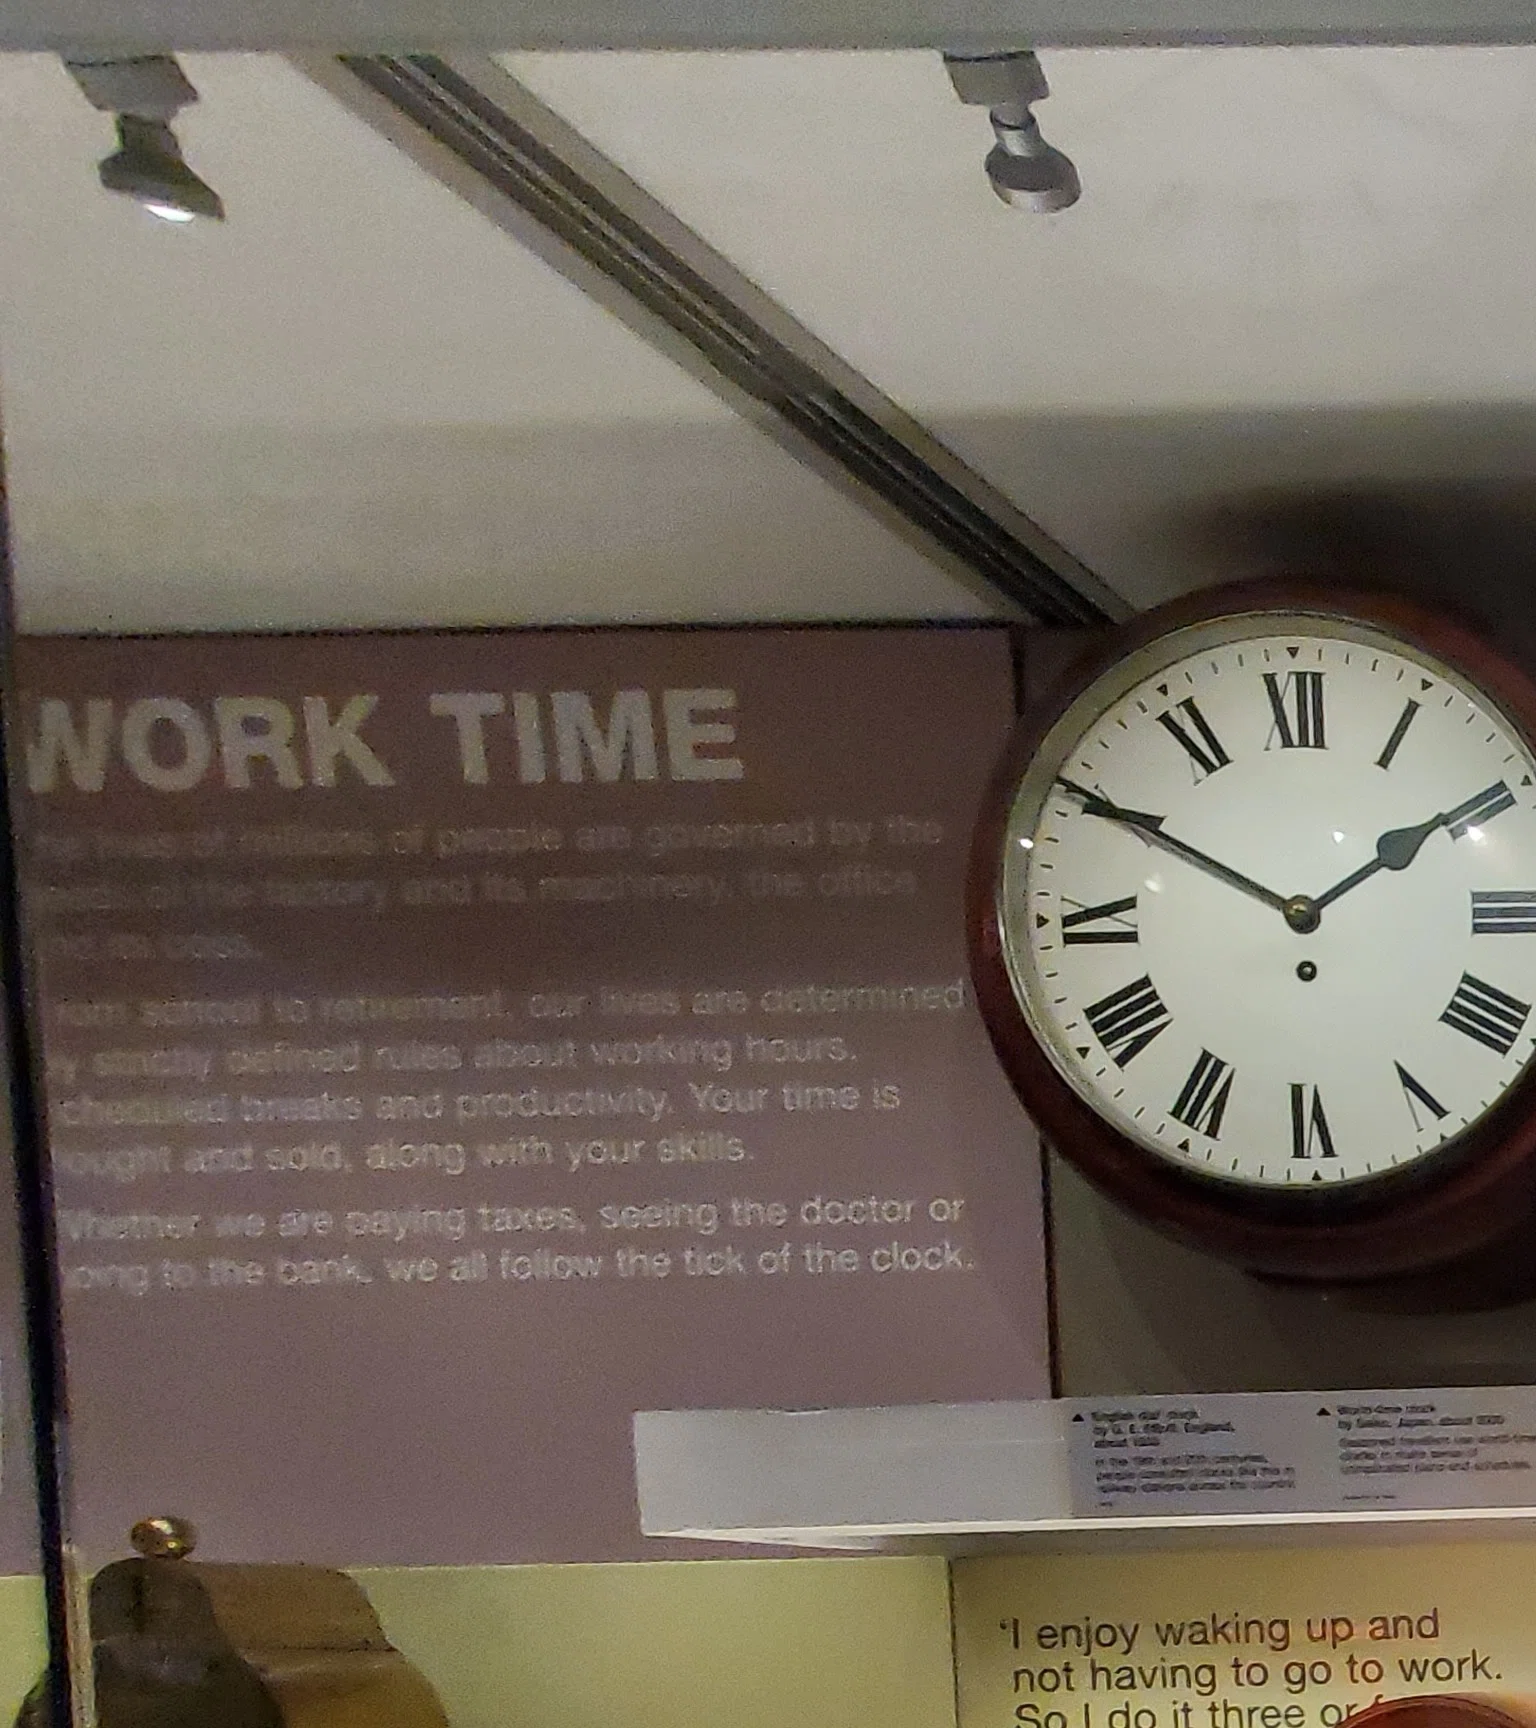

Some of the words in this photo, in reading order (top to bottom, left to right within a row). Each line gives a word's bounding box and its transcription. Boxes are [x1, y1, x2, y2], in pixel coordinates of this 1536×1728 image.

[26, 695, 395, 794] WORK
[430, 687, 745, 785] TIME
[598, 1198, 720, 1231] seeing
[731, 1196, 788, 1226] the
[801, 1193, 916, 1226] doctor
[929, 1196, 963, 1224] or
[498, 1247, 600, 1282] follow
[616, 1249, 674, 1277] the
[684, 1246, 747, 1277] tick
[758, 1244, 801, 1275] of
[804, 1244, 861, 1273] the
[870, 1239, 975, 1273] clock.
[1037, 1616, 1140, 1656] enjoy
[1155, 1612, 1290, 1651] waking
[1307, 1616, 1354, 1649] up
[1369, 1607, 1440, 1640] and
[1013, 1662, 1074, 1693] not
[1090, 1657, 1217, 1696] having
[1231, 1657, 1269, 1687] to
[1284, 1660, 1332, 1694] go
[1347, 1654, 1384, 1684] to
[1399, 1649, 1503, 1682] work.
